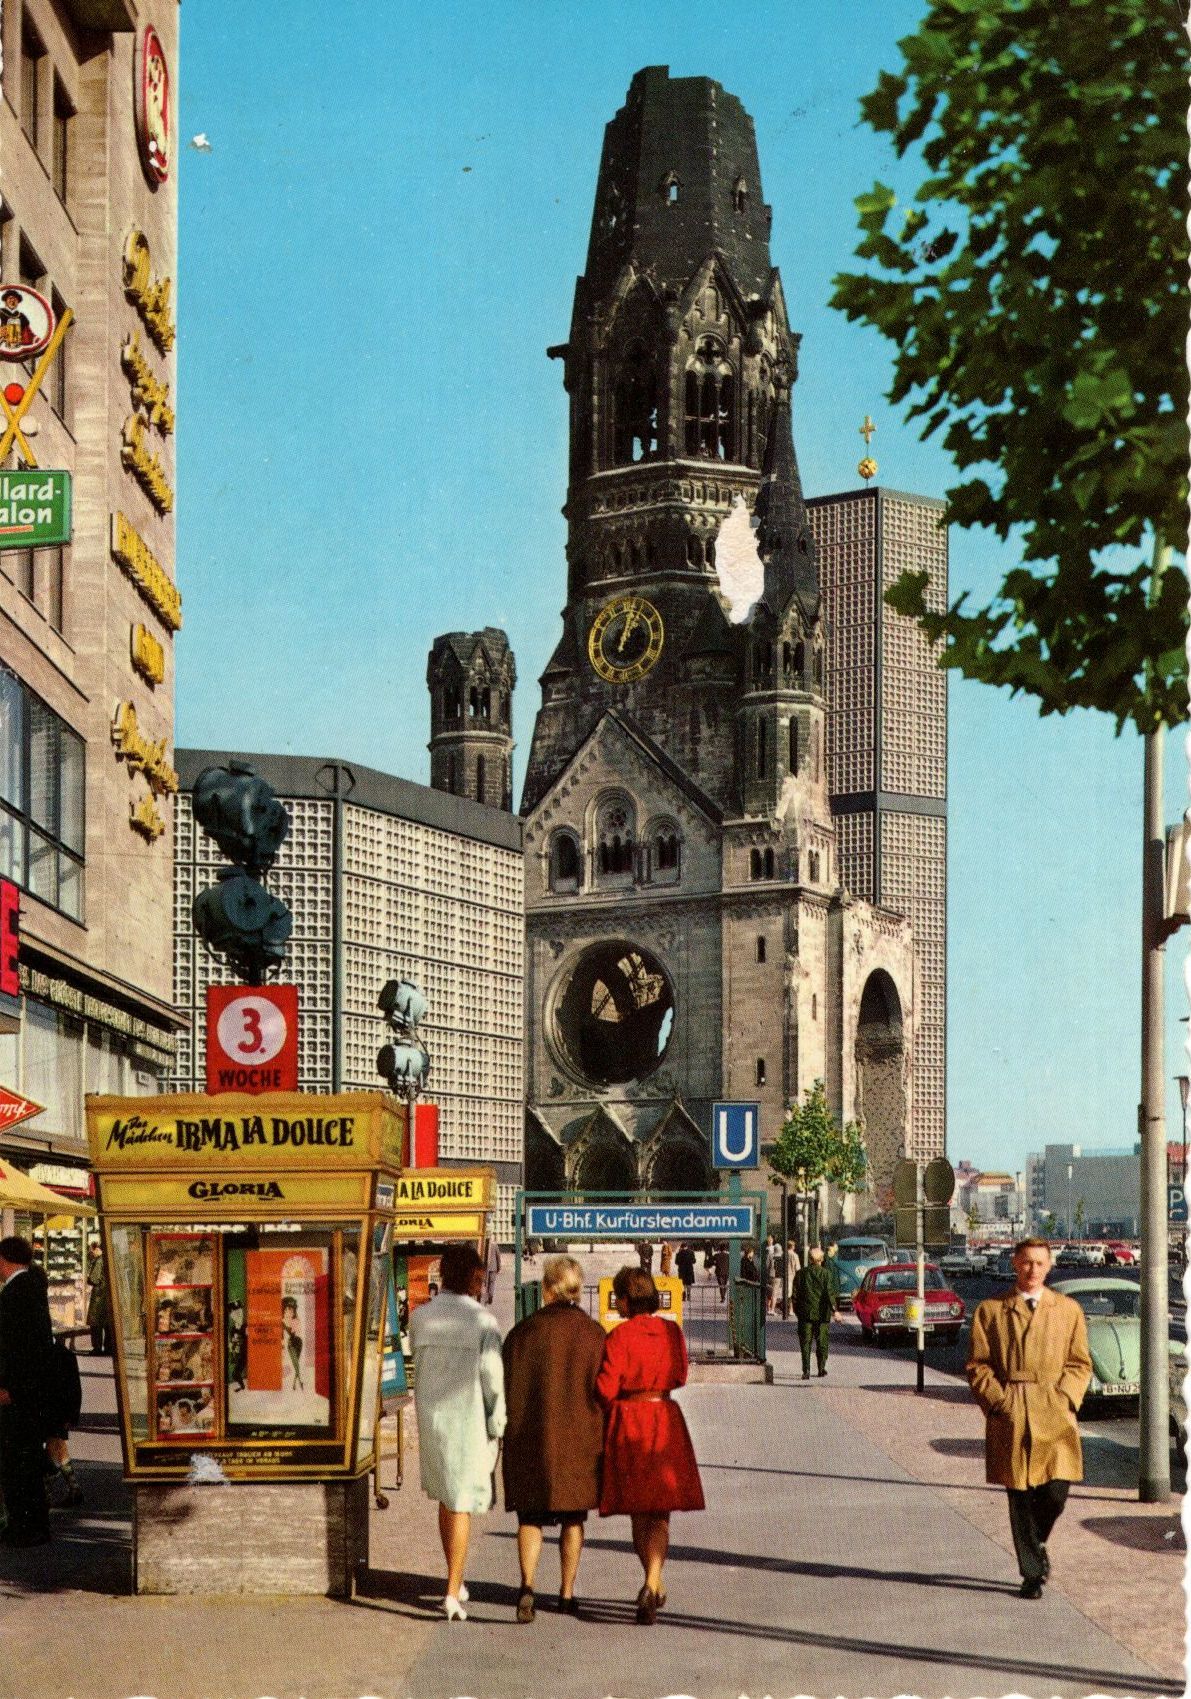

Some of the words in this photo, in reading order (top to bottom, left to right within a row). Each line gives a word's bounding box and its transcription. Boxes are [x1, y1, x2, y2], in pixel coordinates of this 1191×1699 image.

[0, 477, 61, 501] lard-
[238, 1007, 267, 1053] 3.
[218, 1069, 282, 1088] WOCHE
[105, 1119, 173, 1151] Mädchen
[175, 1118, 240, 1152] IRMA
[240, 1115, 268, 1145] LA
[270, 1117, 355, 1147] DOUCE
[719, 1110, 753, 1162] U
[187, 1180, 286, 1201] GLORIA
[411, 1181, 425, 1201] LA
[427, 1181, 473, 1199] DOUCE
[545, 1211, 593, 1229] U-Bhf.
[595, 1211, 738, 1229] Kurfürstendamm
